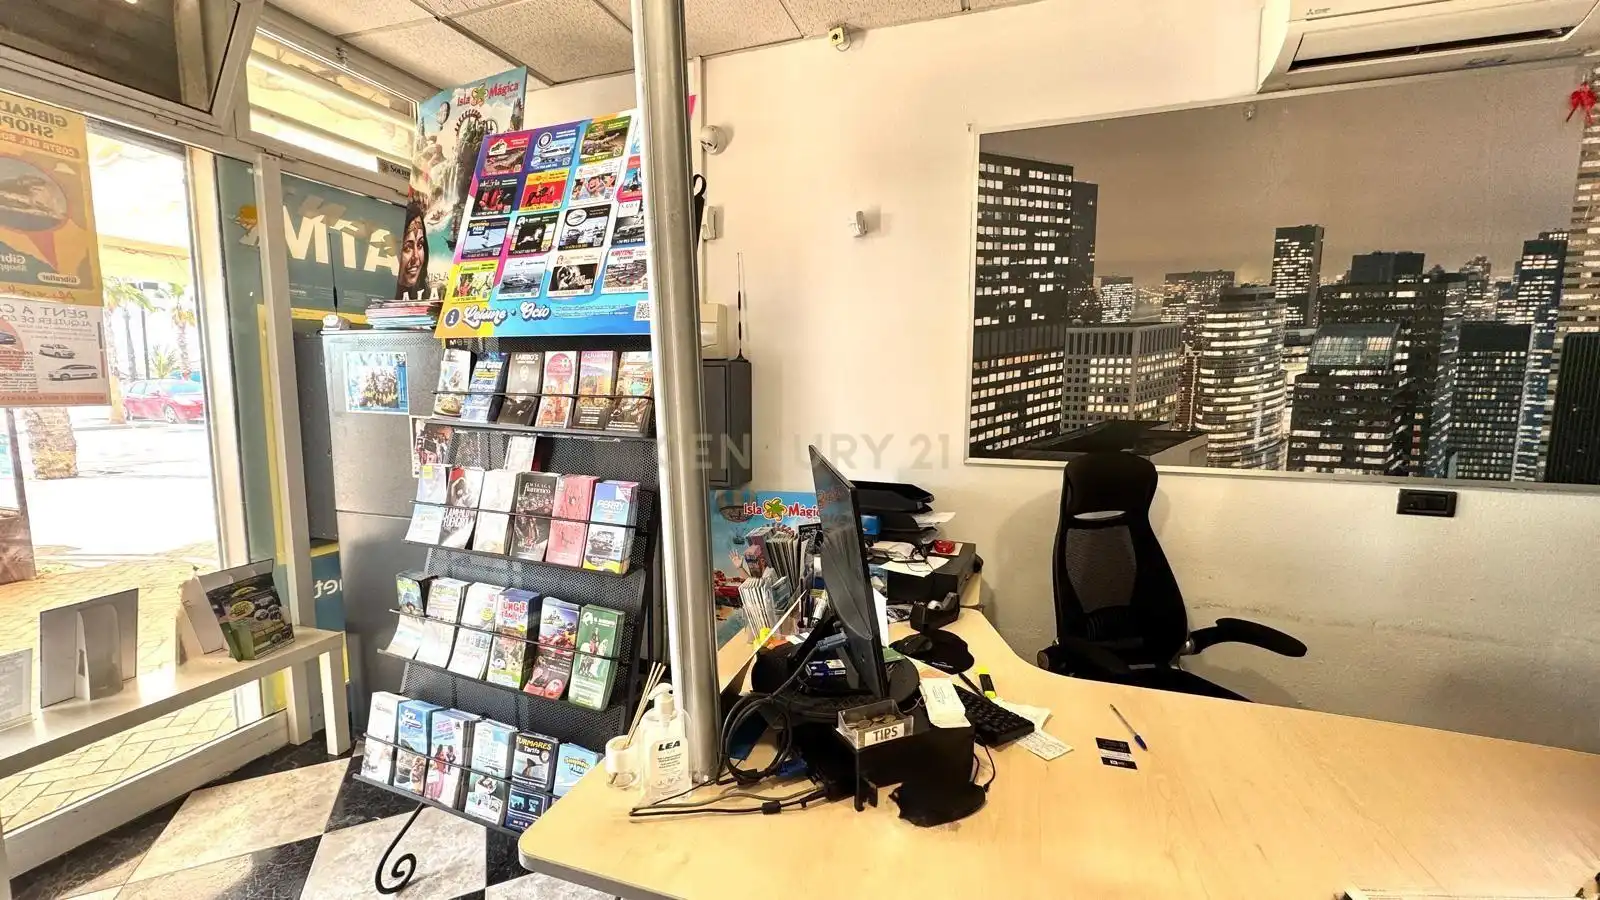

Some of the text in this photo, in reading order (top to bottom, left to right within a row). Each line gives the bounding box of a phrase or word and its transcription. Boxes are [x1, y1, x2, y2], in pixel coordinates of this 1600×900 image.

[457, 93, 471, 107] Isla
[743, 502, 763, 516] Isla
[873, 726, 899, 742] TIPS
[658, 740, 681, 752] LEA
